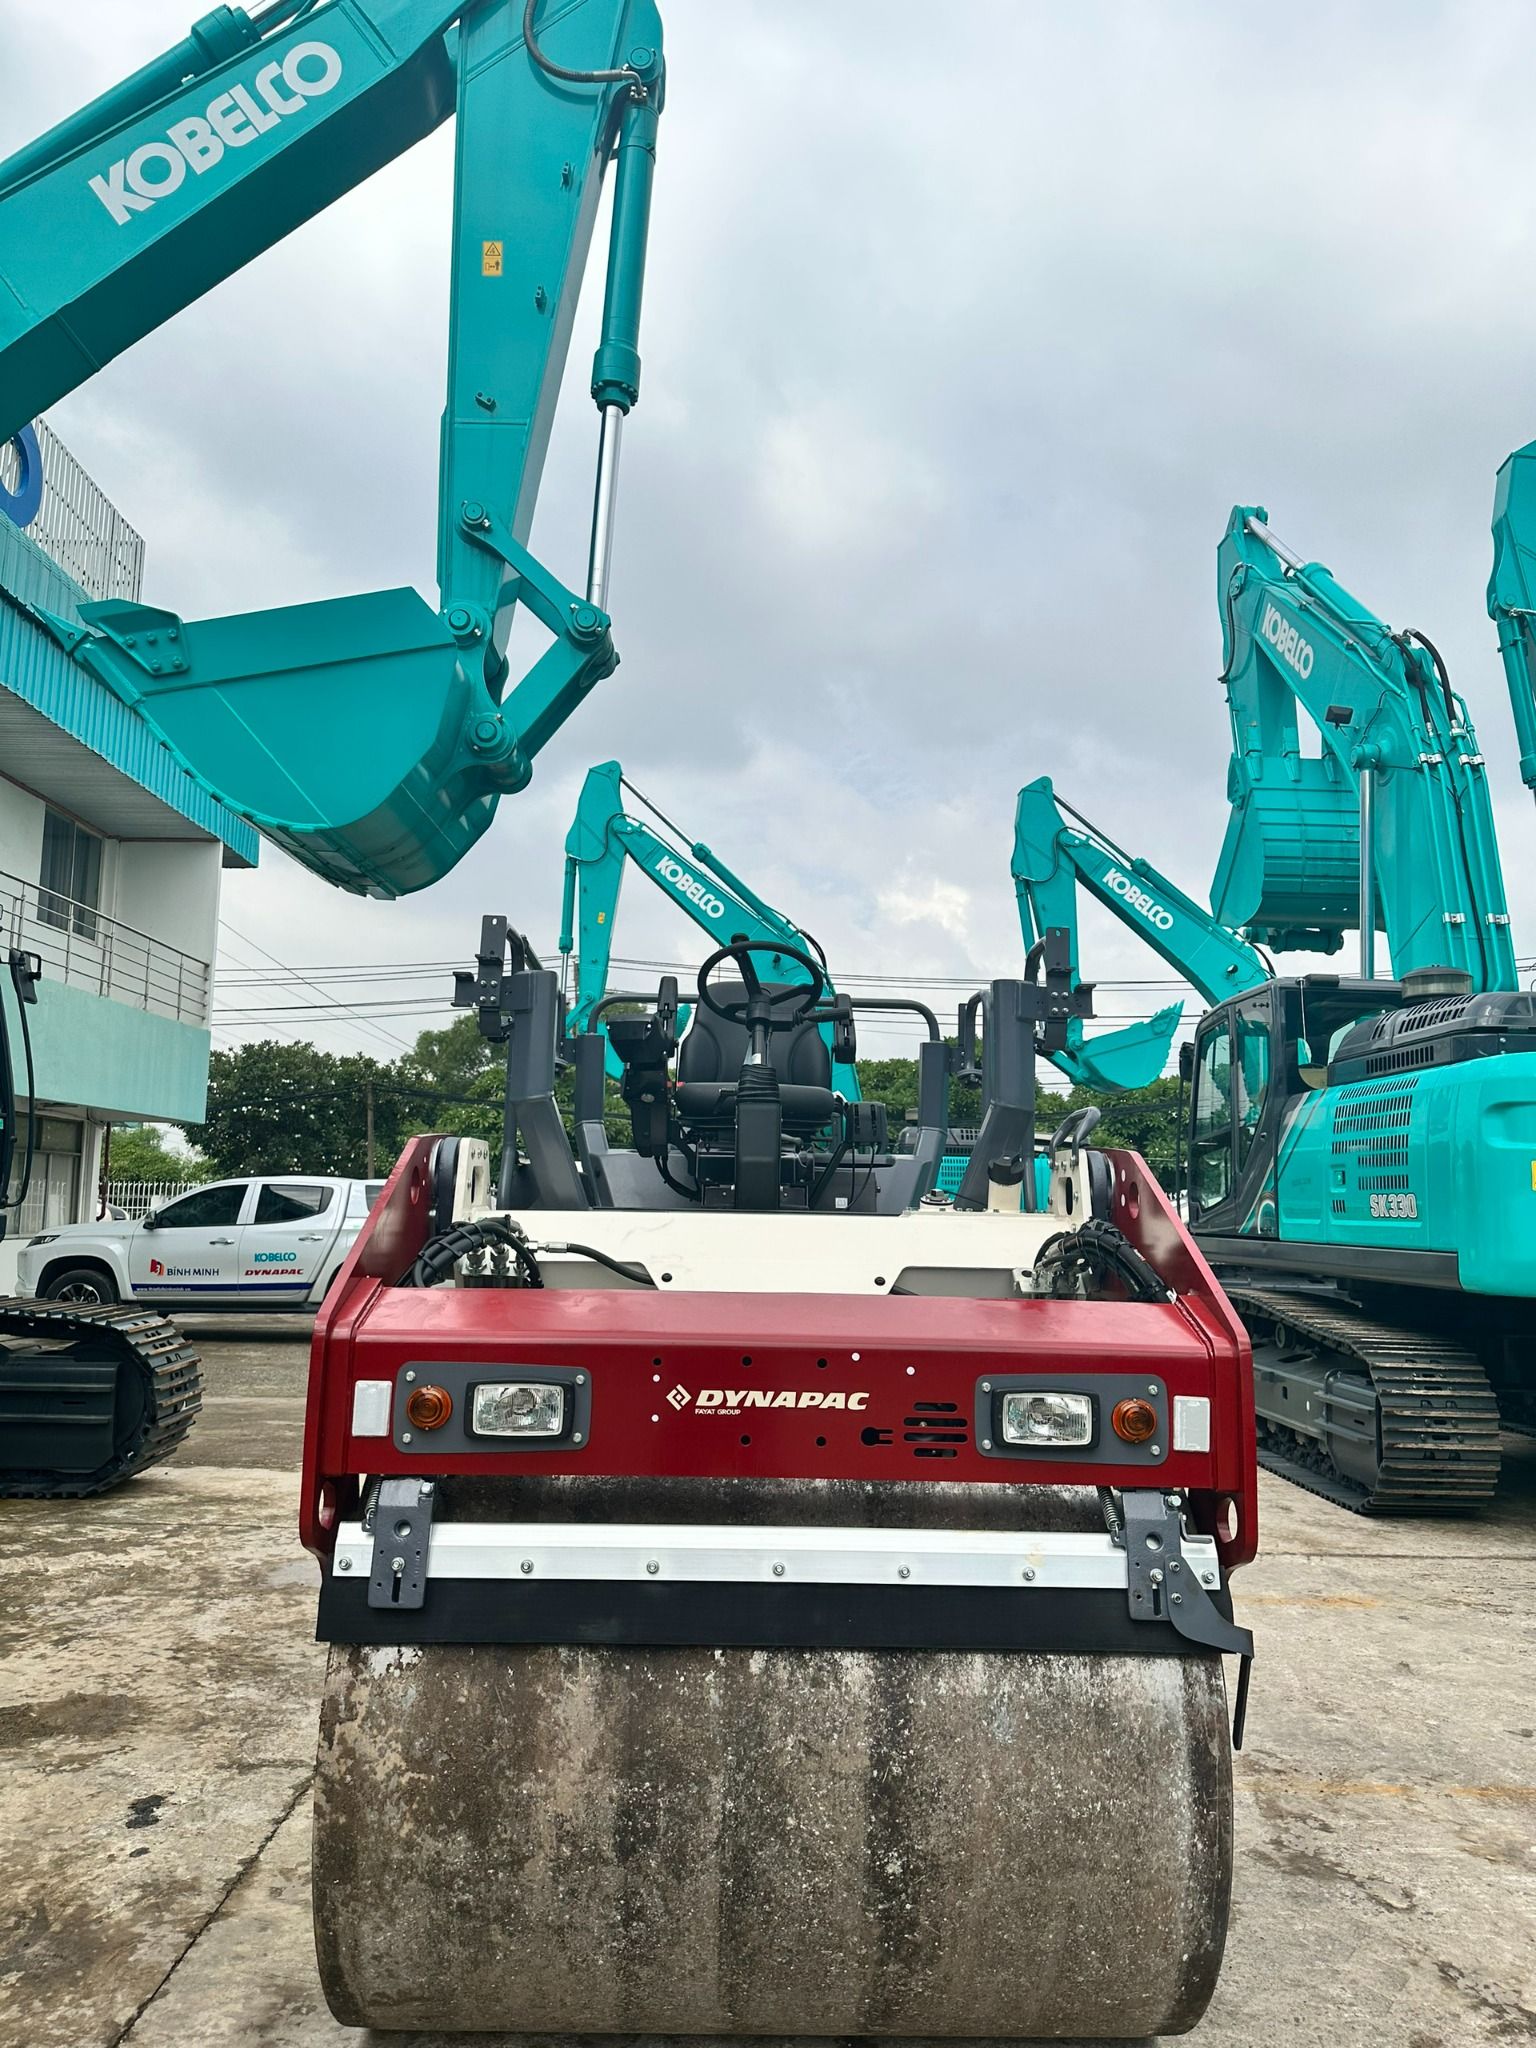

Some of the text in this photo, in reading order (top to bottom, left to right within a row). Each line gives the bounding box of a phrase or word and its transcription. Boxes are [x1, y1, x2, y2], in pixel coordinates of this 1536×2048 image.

[88, 41, 342, 226] KOBELCO
[1261, 602, 1314, 680] KOBELCO
[654, 855, 725, 919] KOBELCO
[1102, 867, 1174, 930] KOBELCO
[1369, 1193, 1418, 1219] SK330
[254, 1252, 297, 1263] KOBELCO
[192, 1268, 220, 1277] MINH
[244, 1268, 304, 1276] DYNAPAC
[695, 1389, 870, 1411] DYNAPAC
